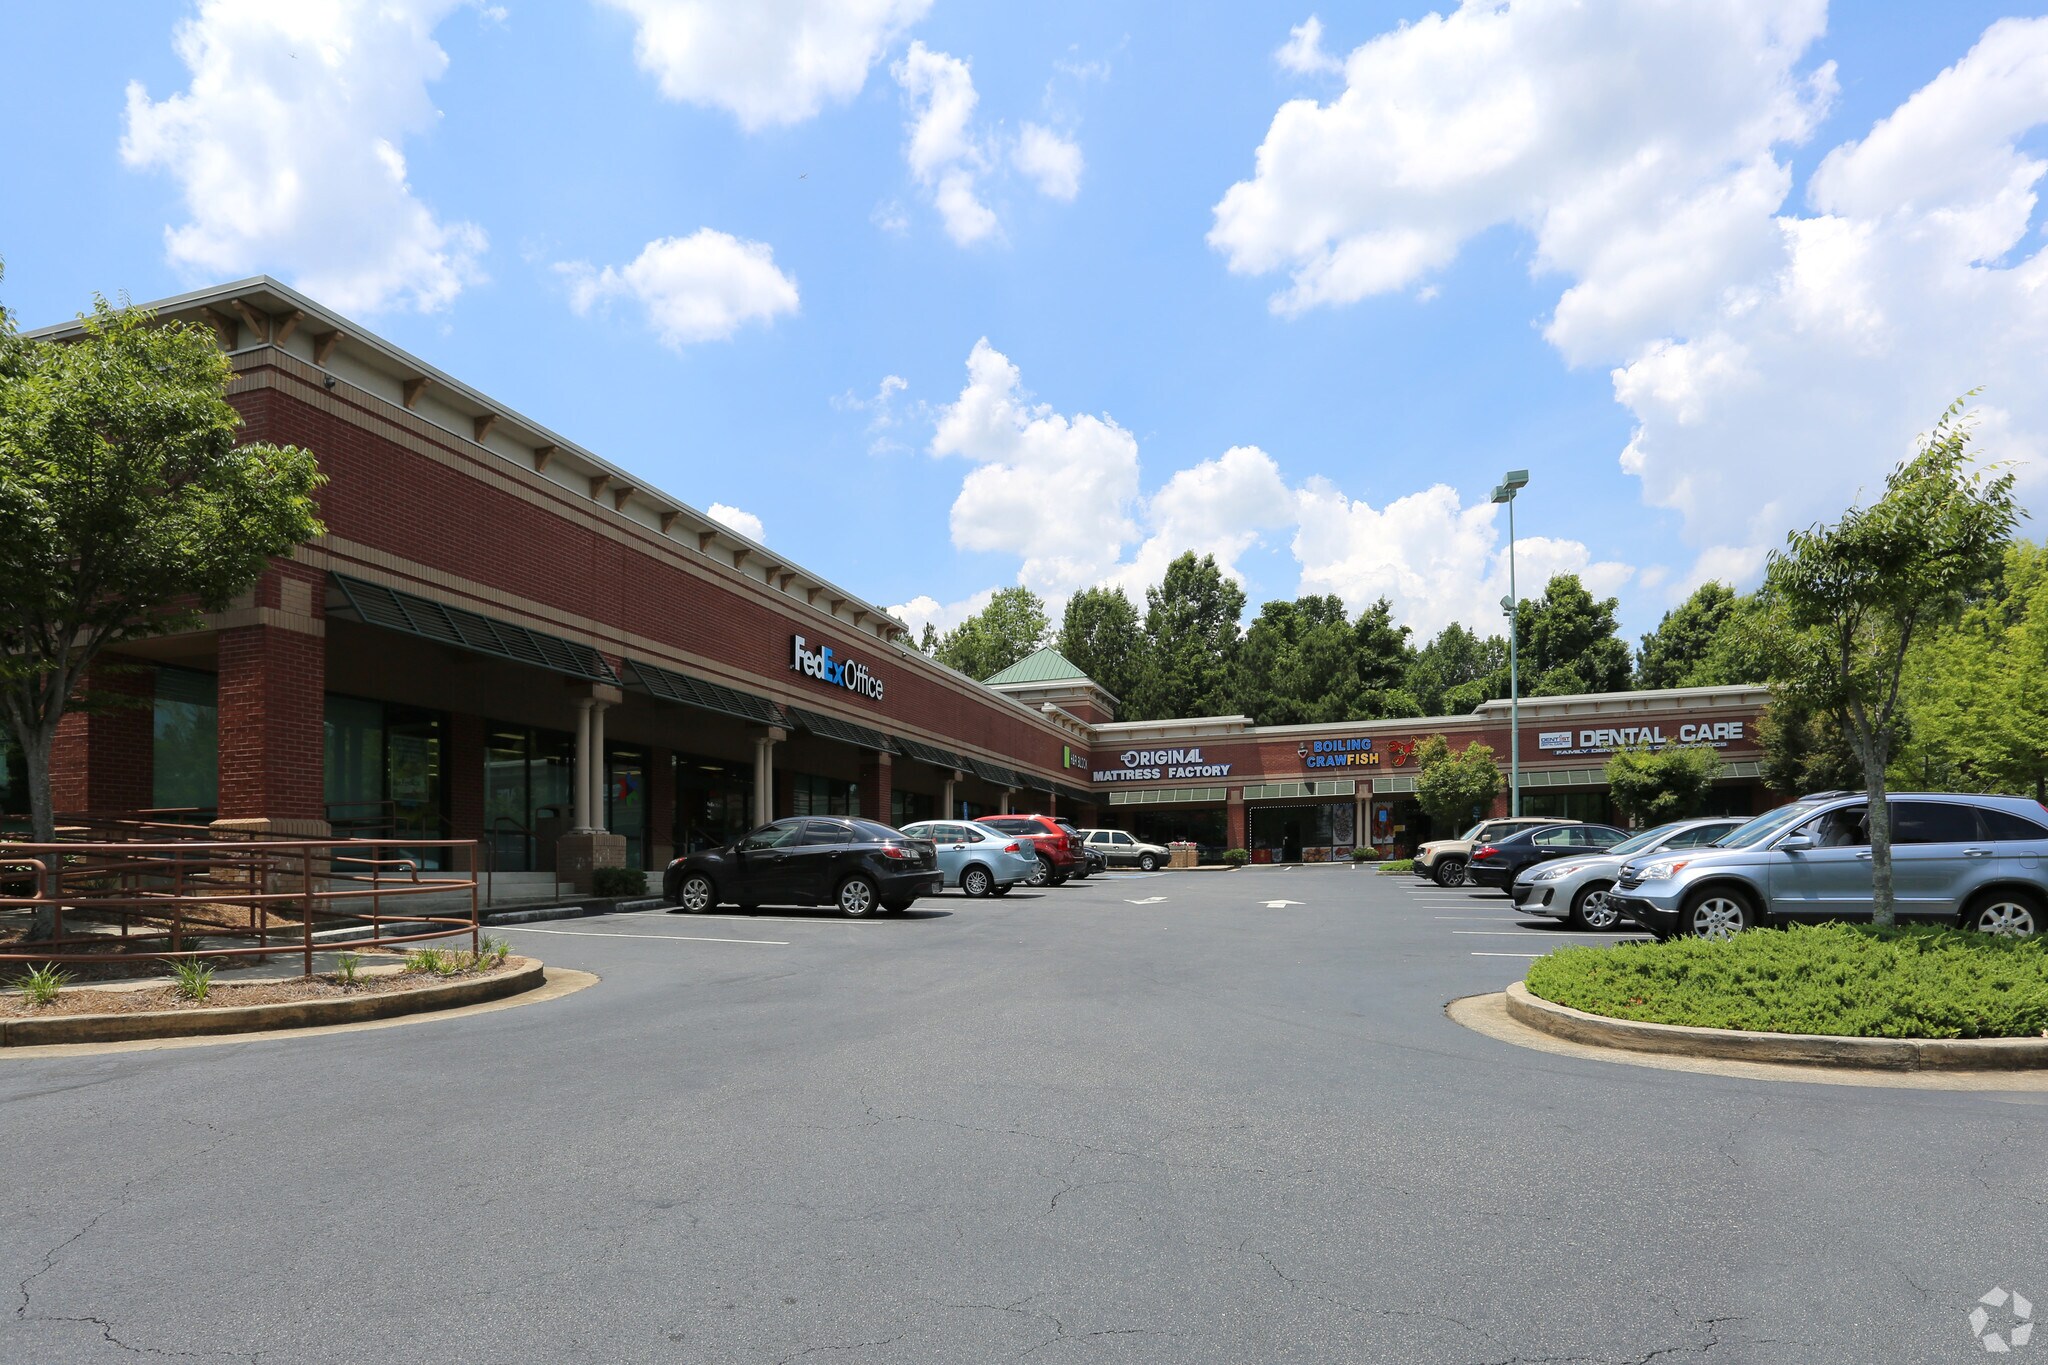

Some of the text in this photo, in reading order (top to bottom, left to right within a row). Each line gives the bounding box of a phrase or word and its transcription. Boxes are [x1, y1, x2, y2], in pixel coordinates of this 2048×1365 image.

[1580, 722, 1743, 747] DENTAL CARE
[1314, 739, 1371, 753] BOILING
[1307, 753, 1379, 767] CRAWFISH
[1093, 765, 1231, 782] MATTRESS FACTORY
